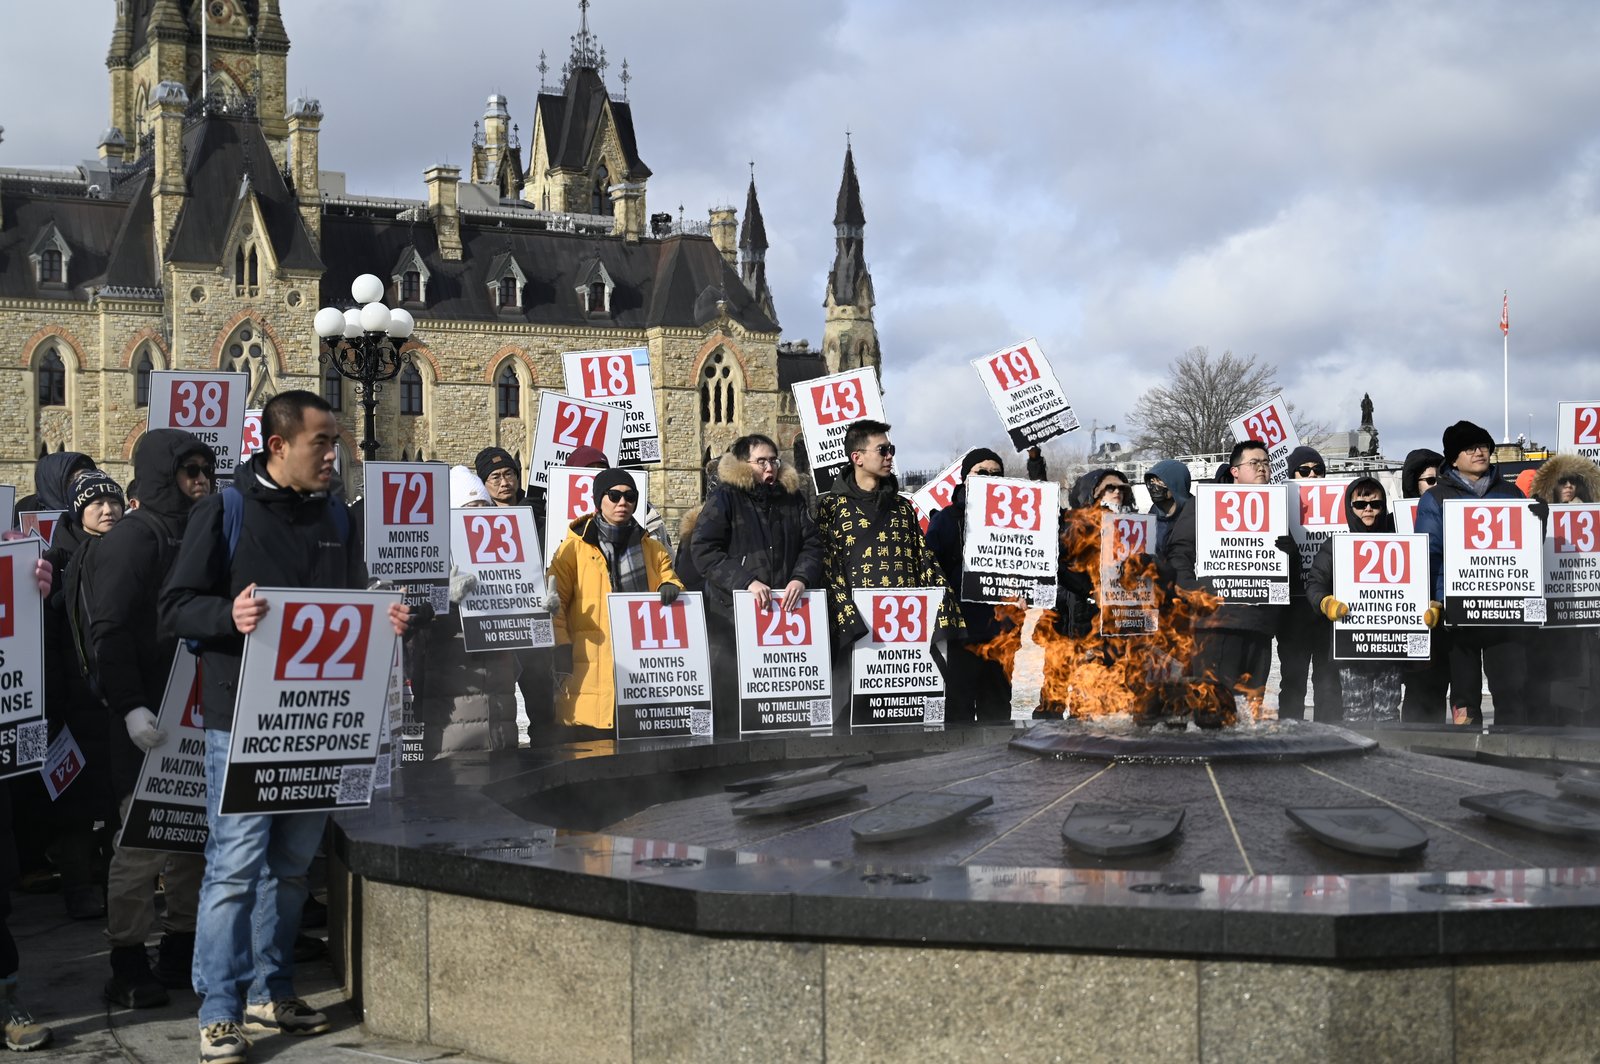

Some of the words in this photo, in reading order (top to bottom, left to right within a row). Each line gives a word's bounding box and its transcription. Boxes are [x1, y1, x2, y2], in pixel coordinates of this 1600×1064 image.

[588, 356, 628, 397] 18
[996, 352, 1032, 388] 19
[1010, 384, 1042, 401] MONTHS
[175, 382, 222, 426] 38
[821, 381, 860, 422] 43
[1007, 396, 1039, 413] WAITING
[1040, 390, 1055, 400] FOR
[626, 412, 644, 421] FOR
[1007, 412, 1025, 425] IRCC
[1024, 397, 1064, 417] RESPONSE
[559, 405, 602, 447] 27
[624, 422, 651, 433] ONSE
[826, 424, 848, 437] MON
[1249, 408, 1282, 449] 35
[1578, 408, 1600, 443] 2
[191, 432, 218, 442] NTHS
[241, 417, 264, 450] 3
[619, 451, 640, 460] SULTS
[816, 452, 836, 463] IRCC
[1268, 446, 1288, 462] ONTHS
[1578, 448, 1600, 457] MON
[828, 467, 840, 476] NO
[1270, 460, 1286, 474] TING
[389, 474, 427, 523] 72
[574, 476, 595, 517] 3
[991, 486, 1036, 530] 33
[1220, 492, 1264, 531] 30
[1308, 486, 1344, 524] 17
[1471, 507, 1515, 549] 31
[1560, 511, 1595, 551] 13
[389, 531, 429, 543] MONTHS
[471, 516, 517, 562] 23
[990, 533, 1034, 545] MONTHS
[1220, 538, 1264, 547] MONTHS
[378, 547, 419, 559] WAITING
[421, 546, 439, 558] FOR
[978, 545, 1022, 557] WAITING
[1025, 549, 1045, 558] FOR
[1298, 543, 1319, 552] WAIT
[1210, 550, 1252, 559] WAITING
[1256, 550, 1275, 559] FOR
[1470, 556, 1516, 565] MONTHS
[372, 562, 393, 574] IRCC
[395, 561, 444, 574] RESPONSE
[970, 557, 993, 567] IRCC
[995, 559, 1050, 571] RESPONSE
[1204, 562, 1225, 570] IRCC
[1228, 562, 1281, 571] RESPONSE
[1360, 542, 1404, 582] 20
[1559, 558, 1596, 568] MONTHS
[478, 569, 521, 581] MONTHS
[1459, 569, 1504, 578] WAITING
[1508, 569, 1528, 578] FOR
[1550, 570, 1586, 580] WAITING
[1590, 570, 1600, 579] FO
[980, 576, 993, 586] NO
[1212, 579, 1225, 588] NO
[1452, 582, 1476, 591] IRCC
[1478, 582, 1535, 591] RESPONSE
[1545, 584, 1564, 593] IRCC
[1566, 582, 1600, 592] RESPON
[471, 584, 512, 596] WAITING
[515, 583, 535, 594] FOR
[982, 587, 996, 596] NO
[998, 588, 1034, 598] RESULTS
[1218, 589, 1229, 598] NO
[1231, 589, 1268, 598] RESULTS
[1360, 590, 1404, 599] MONTHS
[466, 600, 490, 611] IRCC
[490, 597, 542, 610] RESPONSE
[1348, 602, 1392, 612] WAITING
[1396, 603, 1416, 612] FOR
[1463, 600, 1476, 608] NO
[1554, 602, 1564, 610] NO
[878, 597, 921, 642] 33
[1342, 615, 1365, 624] IRCC
[1367, 615, 1422, 624] RESPONSE
[1467, 611, 1479, 619] NO
[1482, 611, 1521, 619] RESULTS
[1558, 611, 1568, 620] NO
[480, 621, 491, 630] NO
[638, 602, 680, 648] 11
[761, 600, 806, 645] 25
[284, 604, 362, 678] 22
[485, 633, 497, 642] NO
[1352, 633, 1365, 641] NO
[878, 649, 921, 660] MONTHS
[1356, 644, 1368, 652] NO
[1371, 644, 1408, 652] RESULTS
[640, 657, 684, 669] MONTHS
[763, 652, 807, 663] MONTHS
[753, 666, 796, 678] WAITING
[799, 666, 819, 676] FOR
[866, 664, 910, 675] WAITING
[913, 662, 933, 673] FOR
[0, 670, 23, 690] OR
[629, 671, 674, 684] WAITING
[676, 671, 697, 681] FOR
[860, 678, 882, 688] IRCC
[884, 676, 938, 688] RESPONSE
[624, 688, 647, 699] IRCC
[649, 685, 704, 697] RESPONSE
[747, 682, 770, 693] IRCC
[771, 679, 825, 692] RESPONSE
[279, 690, 350, 708] MONTHS
[870, 698, 882, 707] NO
[758, 702, 770, 712] NO
[772, 700, 810, 711] TIMELINE
[873, 708, 885, 718] NO
[887, 707, 924, 717] RESULTS
[635, 709, 647, 718] NO
[762, 714, 774, 724] NO
[258, 713, 328, 731] WAITING
[333, 712, 365, 728] FOR
[640, 720, 652, 730] NO
[654, 719, 690, 729] RESULTS
[179, 738, 206, 756] MON
[242, 737, 281, 754] IRCC
[283, 734, 371, 752] RESPONSE
[402, 754, 424, 762] RESU
[56, 755, 73, 782] 24
[160, 757, 206, 778] WAITIN
[255, 769, 275, 784] NO
[146, 776, 174, 794] IRCC
[174, 780, 207, 798] RESP
[258, 786, 278, 801] NO
[281, 784, 340, 800] RESULTS
[149, 808, 164, 822] NO
[166, 810, 208, 826] TIMELINE
[148, 826, 163, 840] NO
[164, 828, 207, 843] RESULTS
